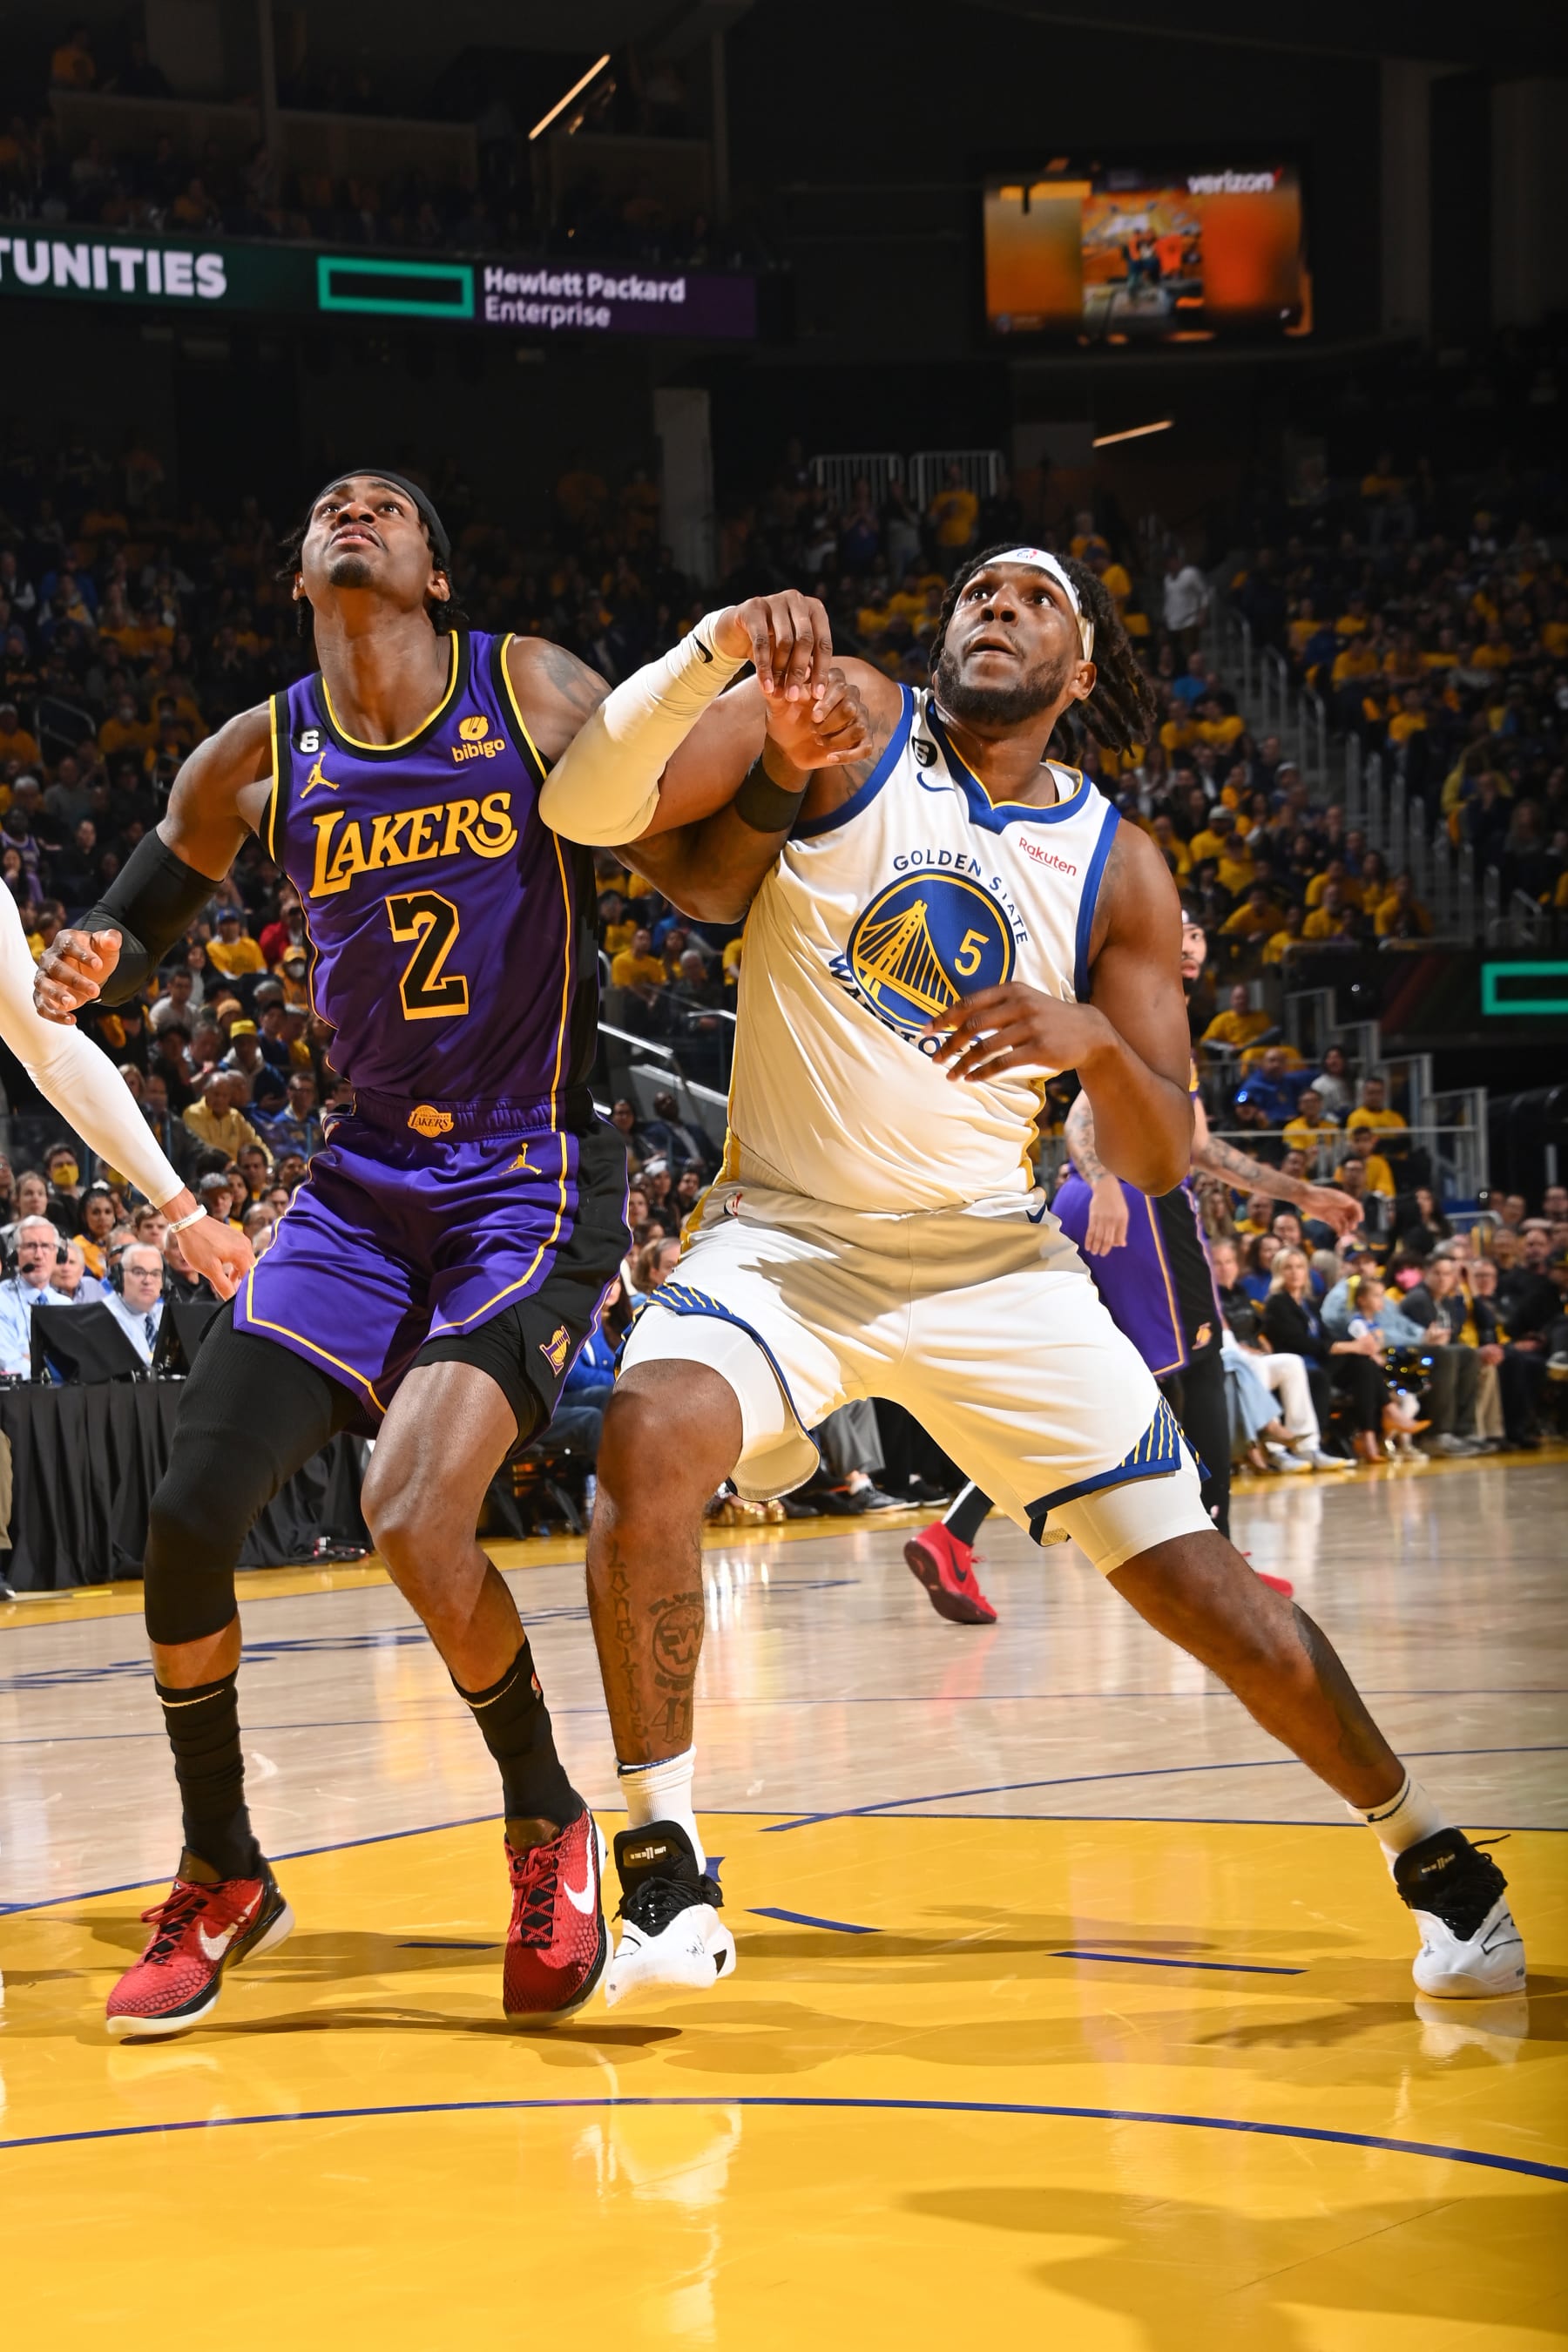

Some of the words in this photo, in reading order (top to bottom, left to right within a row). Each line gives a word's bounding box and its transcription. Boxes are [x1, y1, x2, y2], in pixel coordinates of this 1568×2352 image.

[1187, 170, 1274, 194] verizon
[484, 266, 584, 297] Hewlett
[586, 272, 686, 303] Packard
[484, 294, 611, 330] Enterprise
[300, 728, 320, 754] 6
[451, 738, 506, 763] bibigo
[308, 791, 518, 898] LAKERS
[1018, 836, 1078, 877] Rakuten
[893, 848, 982, 878] GOLDEN
[384, 889, 470, 1021] 2
[955, 928, 990, 977] 5
[410, 1112, 451, 1131] LAKERS
